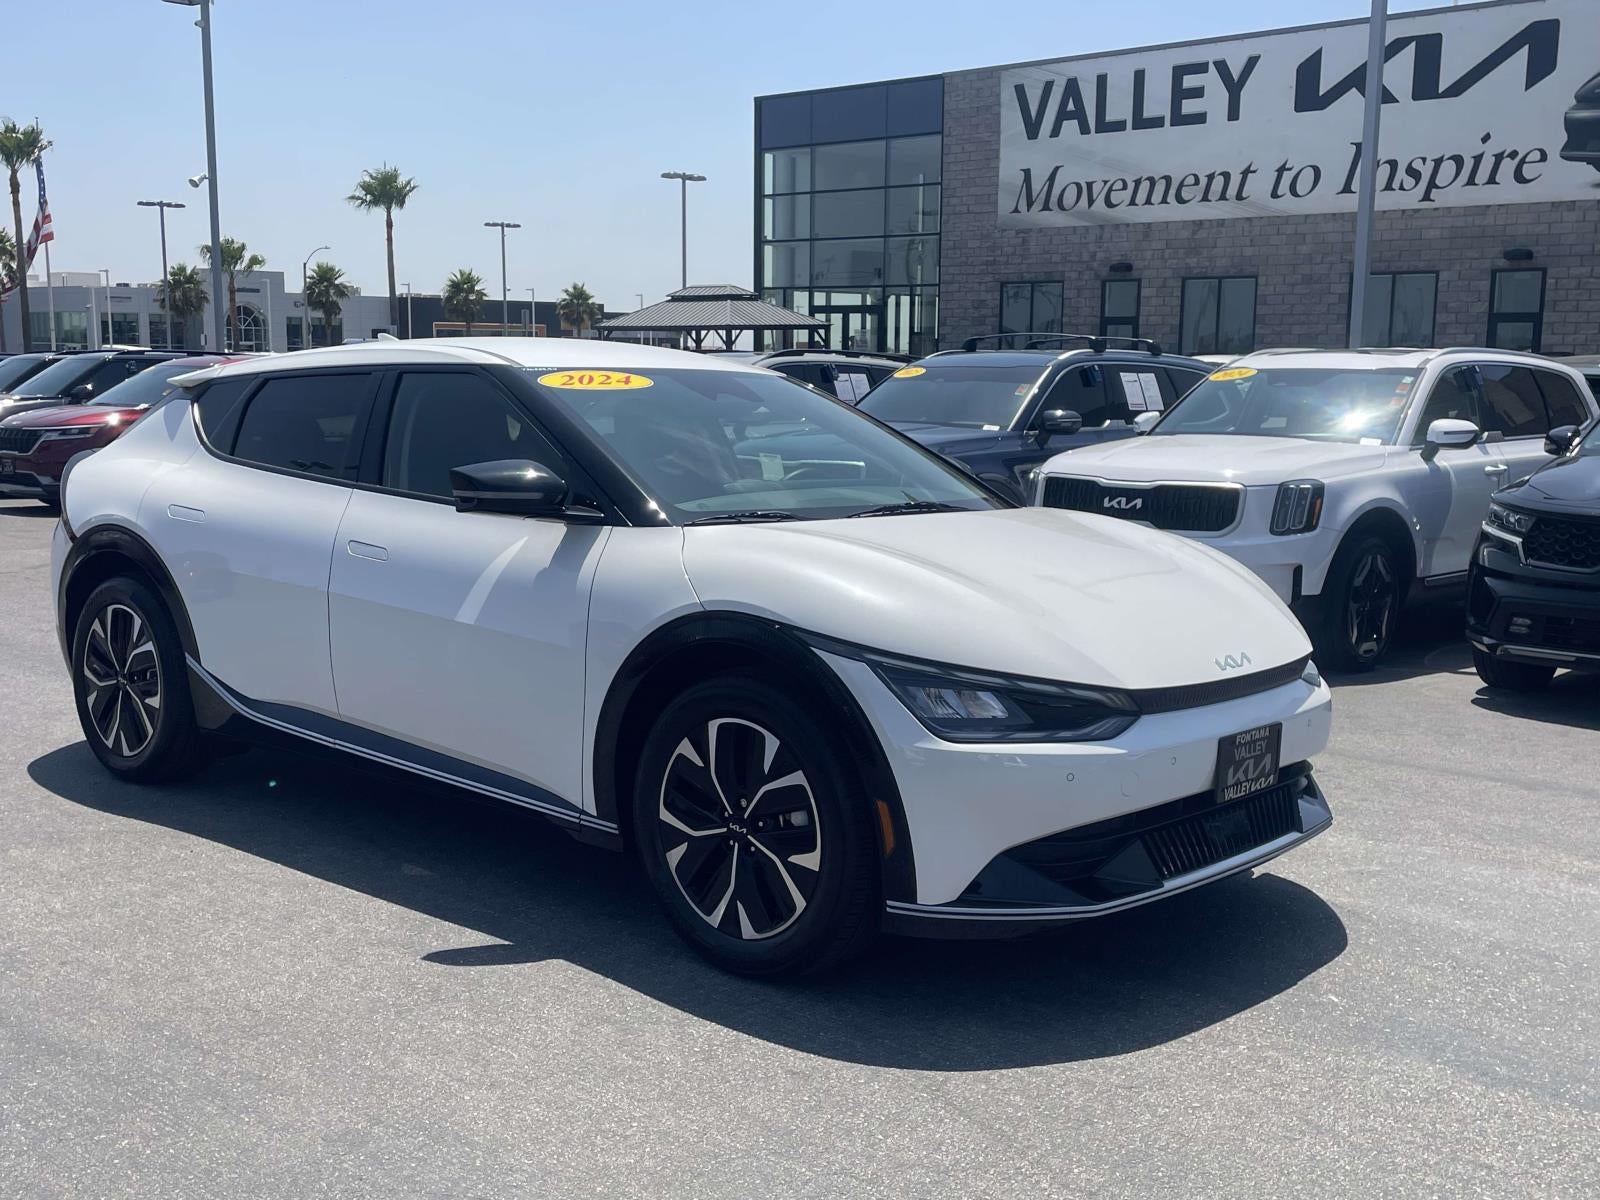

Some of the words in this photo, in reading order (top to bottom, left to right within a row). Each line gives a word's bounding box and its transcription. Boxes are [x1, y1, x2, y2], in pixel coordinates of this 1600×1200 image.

[1014, 54, 1261, 141] VALLEY
[1294, 18, 1560, 113] KIA
[1009, 160, 1258, 215] Movement
[1270, 159, 1322, 199] to
[1336, 132, 1548, 203] Inspire
[560, 374, 632, 386] 2024
[1103, 496, 1143, 510] KIA
[1214, 651, 1252, 671] KIA
[1236, 727, 1270, 745] FONTANA
[1234, 739, 1268, 760] VALLEY
[1227, 753, 1271, 785] KIA
